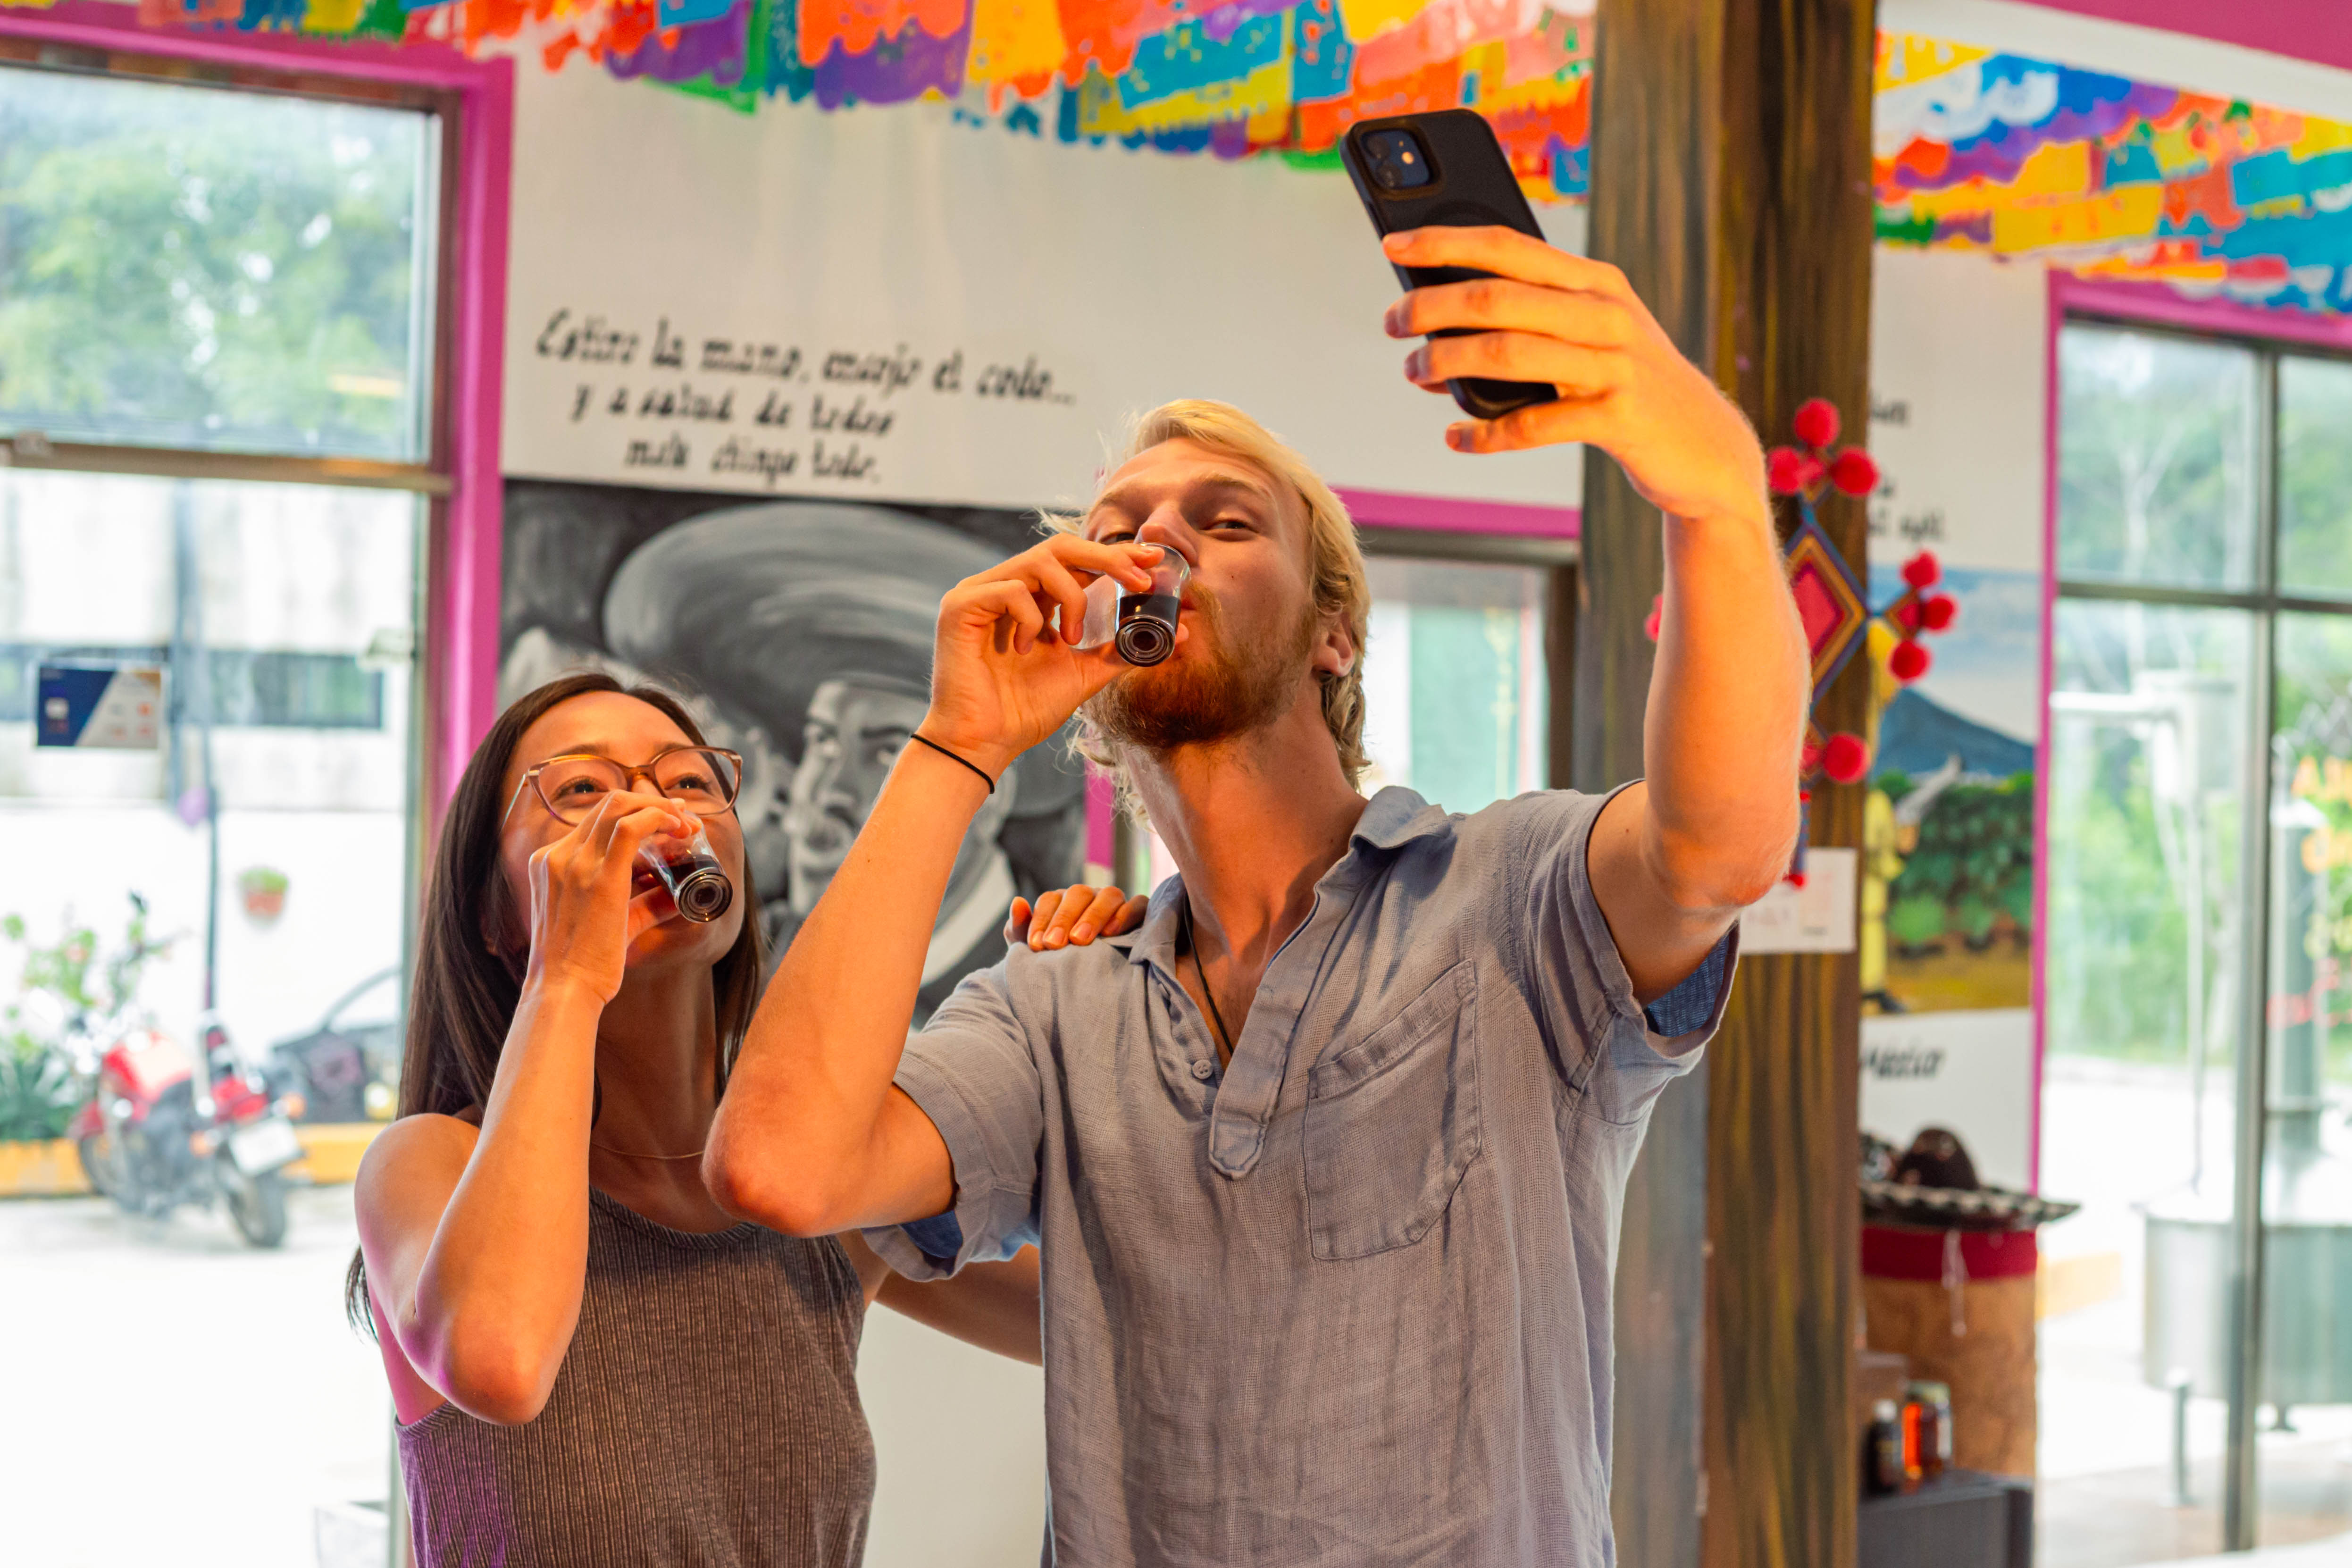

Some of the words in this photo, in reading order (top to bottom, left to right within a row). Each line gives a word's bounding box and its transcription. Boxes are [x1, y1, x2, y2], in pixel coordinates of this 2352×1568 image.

[651, 315, 684, 370] la
[932, 348, 964, 393] el
[569, 384, 593, 422] y
[609, 387, 628, 416] a
[637, 382, 733, 422] salud
[755, 390, 794, 428] de
